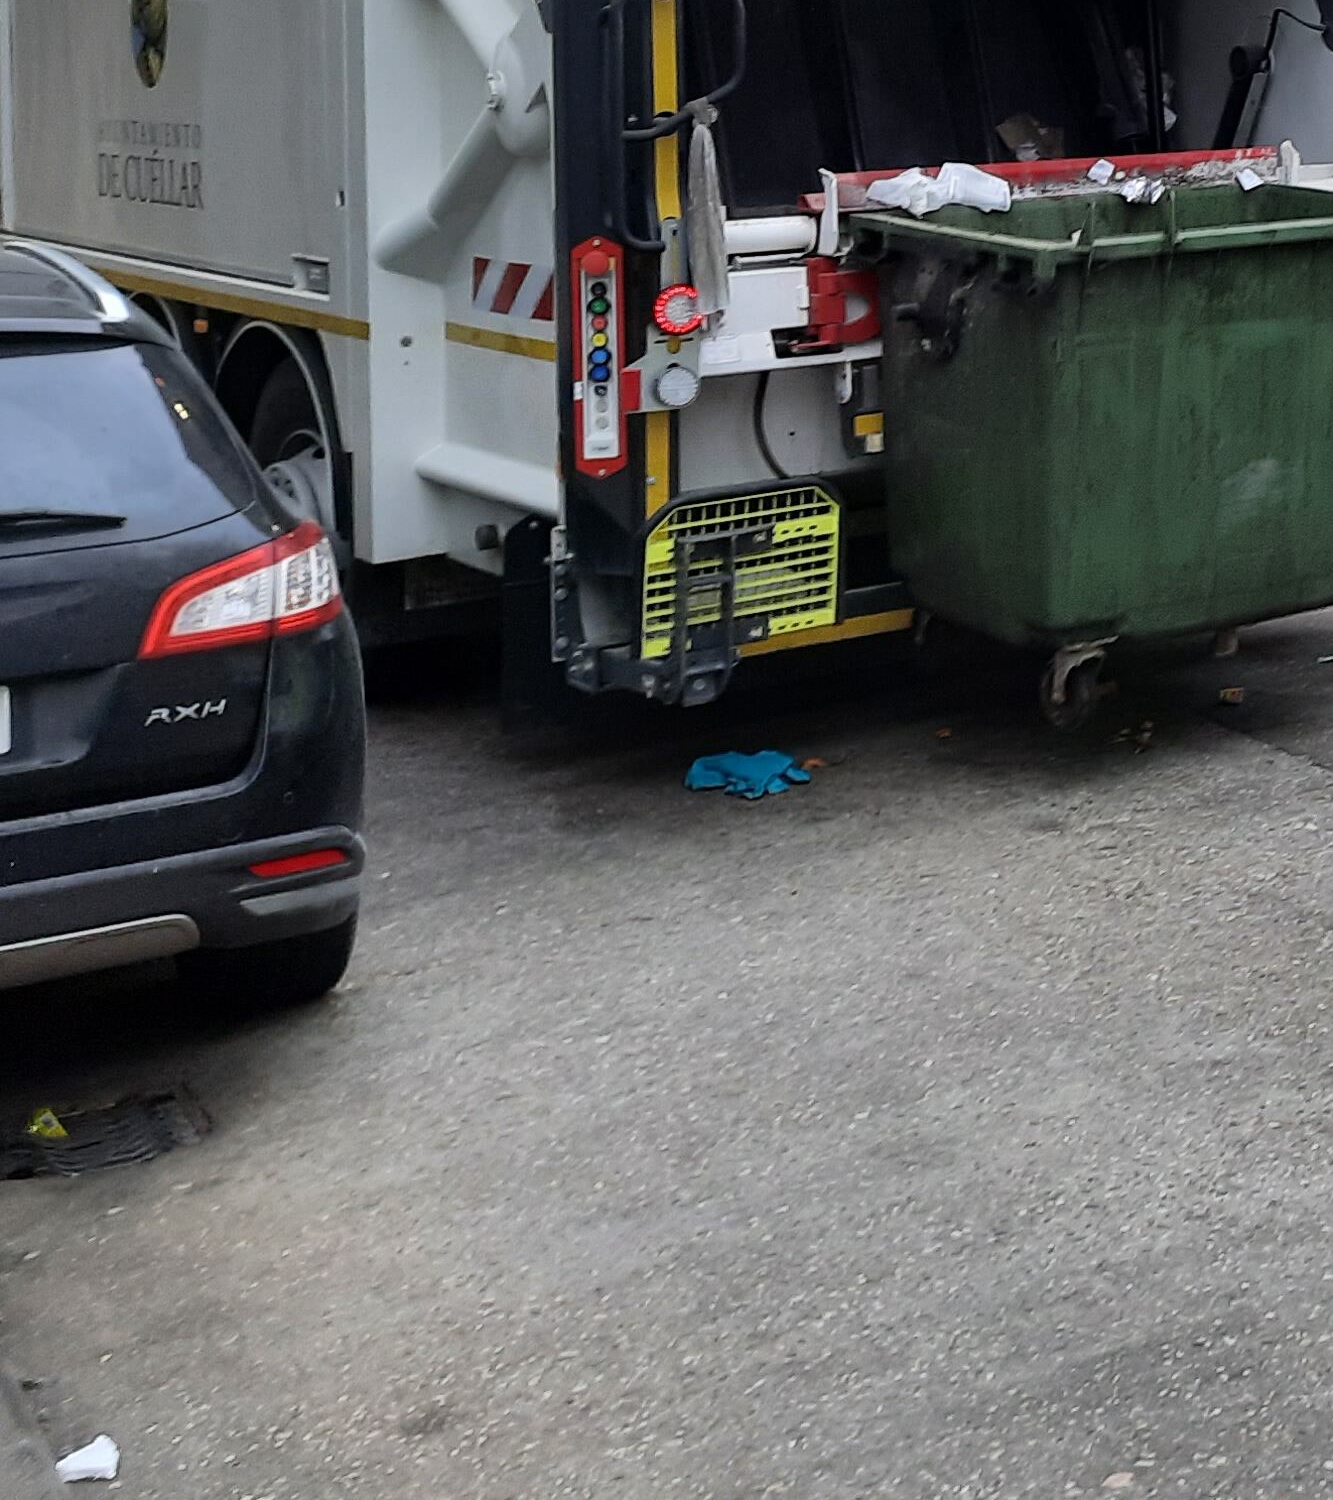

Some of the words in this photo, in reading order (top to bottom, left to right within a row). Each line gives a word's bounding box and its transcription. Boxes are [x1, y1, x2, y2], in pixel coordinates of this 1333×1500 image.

[98, 153, 121, 198] DE
[124, 149, 204, 210] CUÉLLAR
[143, 698, 226, 727] RXH
